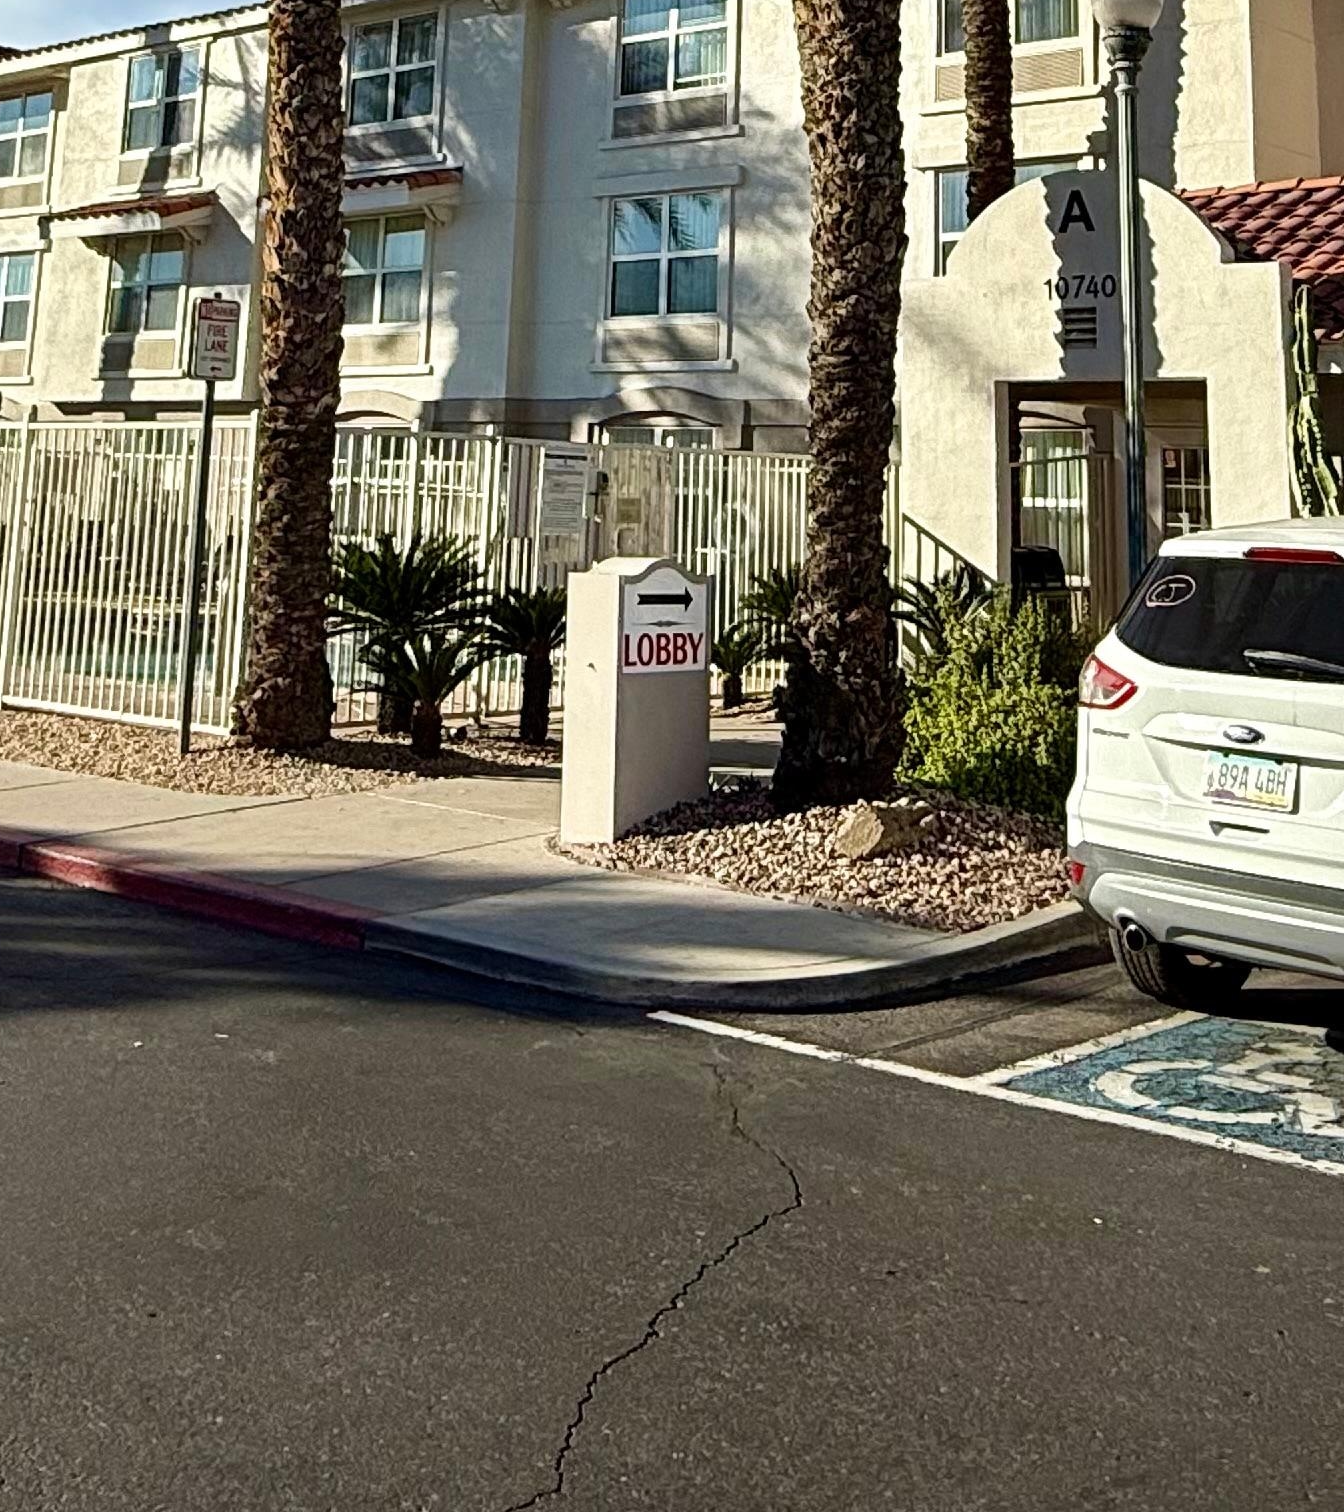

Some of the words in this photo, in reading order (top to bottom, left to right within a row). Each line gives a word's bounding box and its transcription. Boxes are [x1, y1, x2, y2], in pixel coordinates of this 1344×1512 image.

[1058, 189, 1096, 234] A
[1043, 274, 1117, 301] 10740
[207, 324, 229, 338] FIRE
[204, 338, 229, 353] LANE
[623, 632, 704, 667] LOBBY
